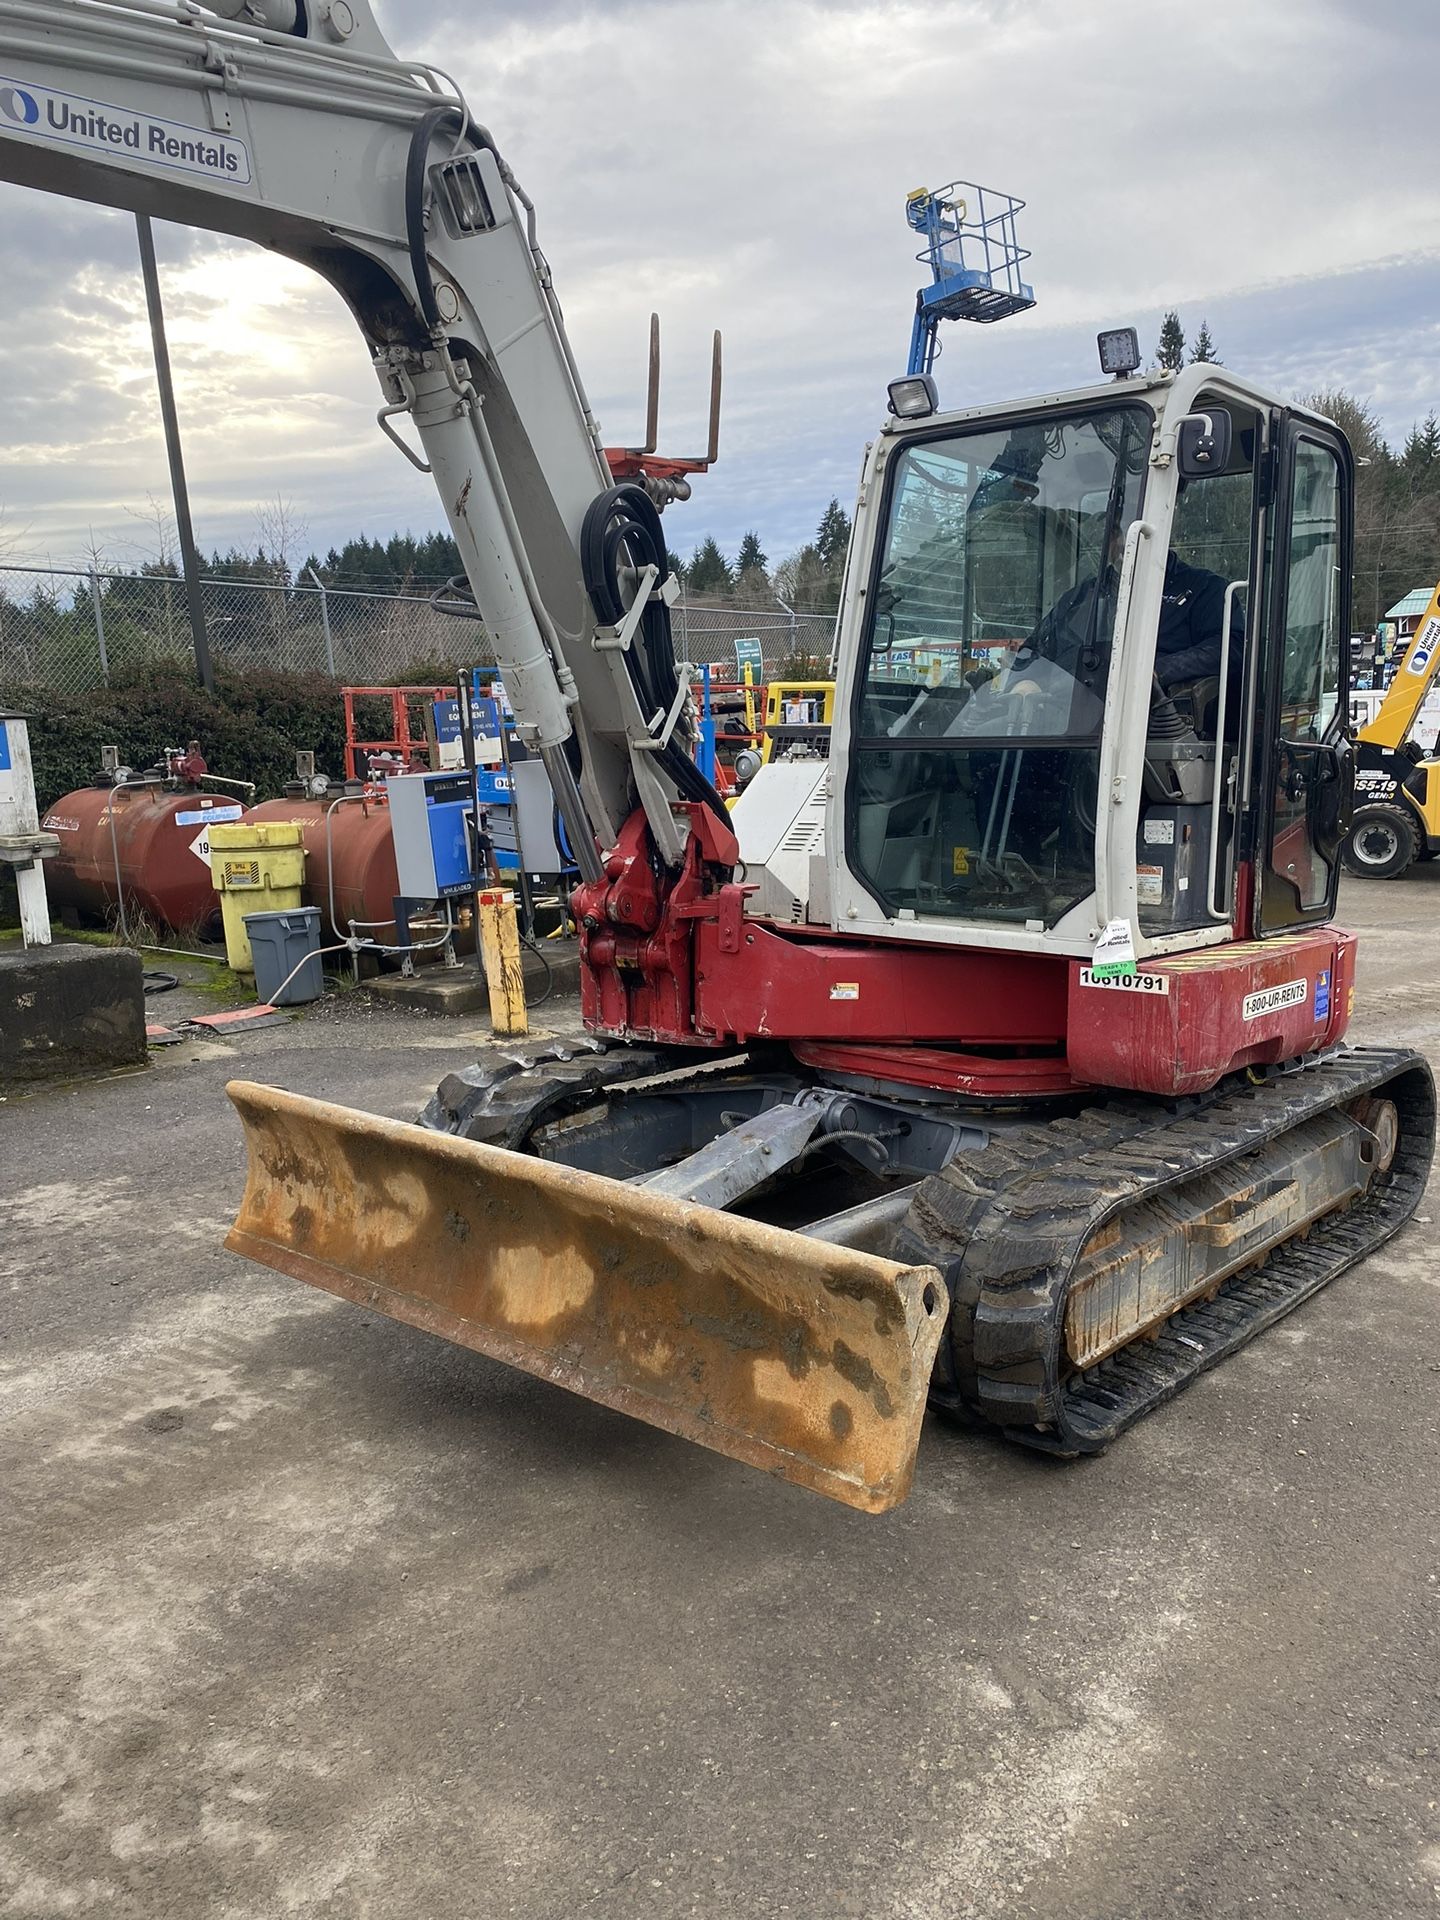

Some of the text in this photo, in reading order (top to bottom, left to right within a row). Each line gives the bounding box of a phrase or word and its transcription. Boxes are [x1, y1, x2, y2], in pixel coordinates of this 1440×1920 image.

[47, 98, 238, 172] United Rentals
[1419, 621, 1437, 650] United
[1426, 623, 1440, 652] Rental
[443, 883, 472, 895] UNLEADED
[1245, 983, 1305, 1015] 1-800-UR-RENTS
